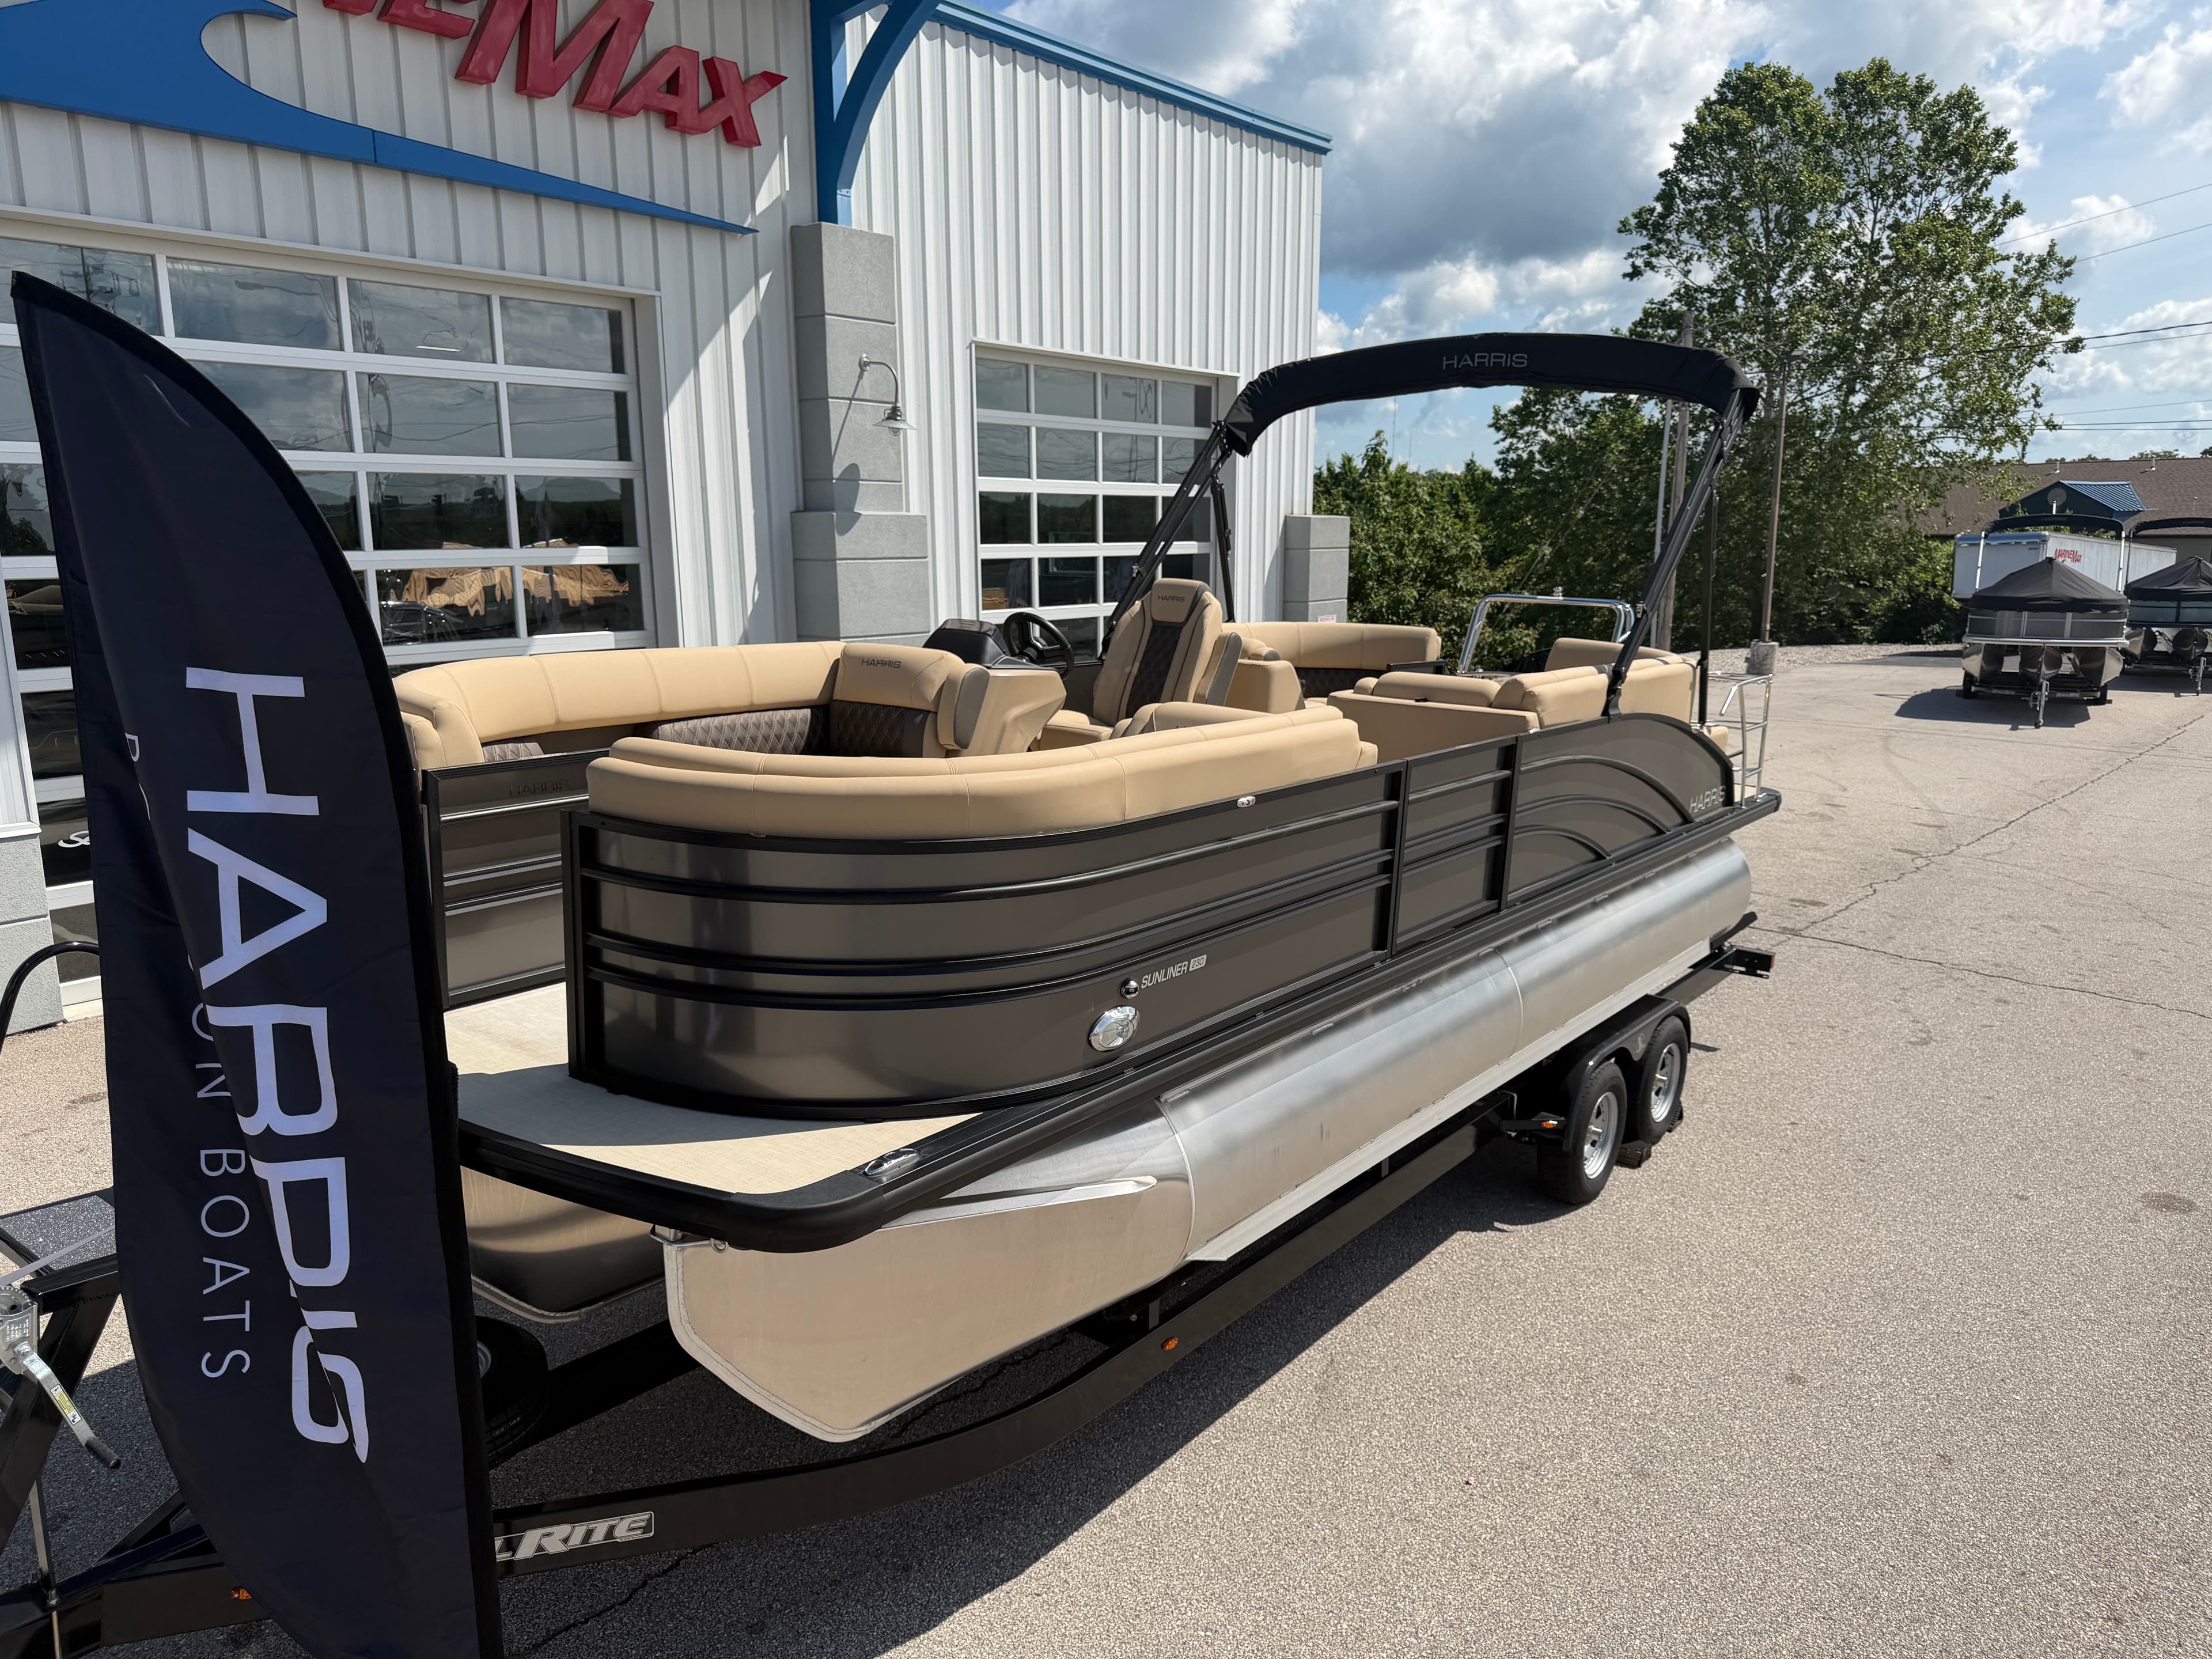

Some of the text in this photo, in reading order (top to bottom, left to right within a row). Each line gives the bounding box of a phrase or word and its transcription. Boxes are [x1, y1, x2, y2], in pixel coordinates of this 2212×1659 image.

[1442, 353, 1528, 370] HARRIS
[1157, 594, 1185, 603] HARRIS
[861, 658, 902, 669] HARRIS
[1689, 785, 1726, 813] HARRIS
[1141, 956, 1205, 989] SUNLINER 230
[199, 1148, 251, 1378] BOATS
